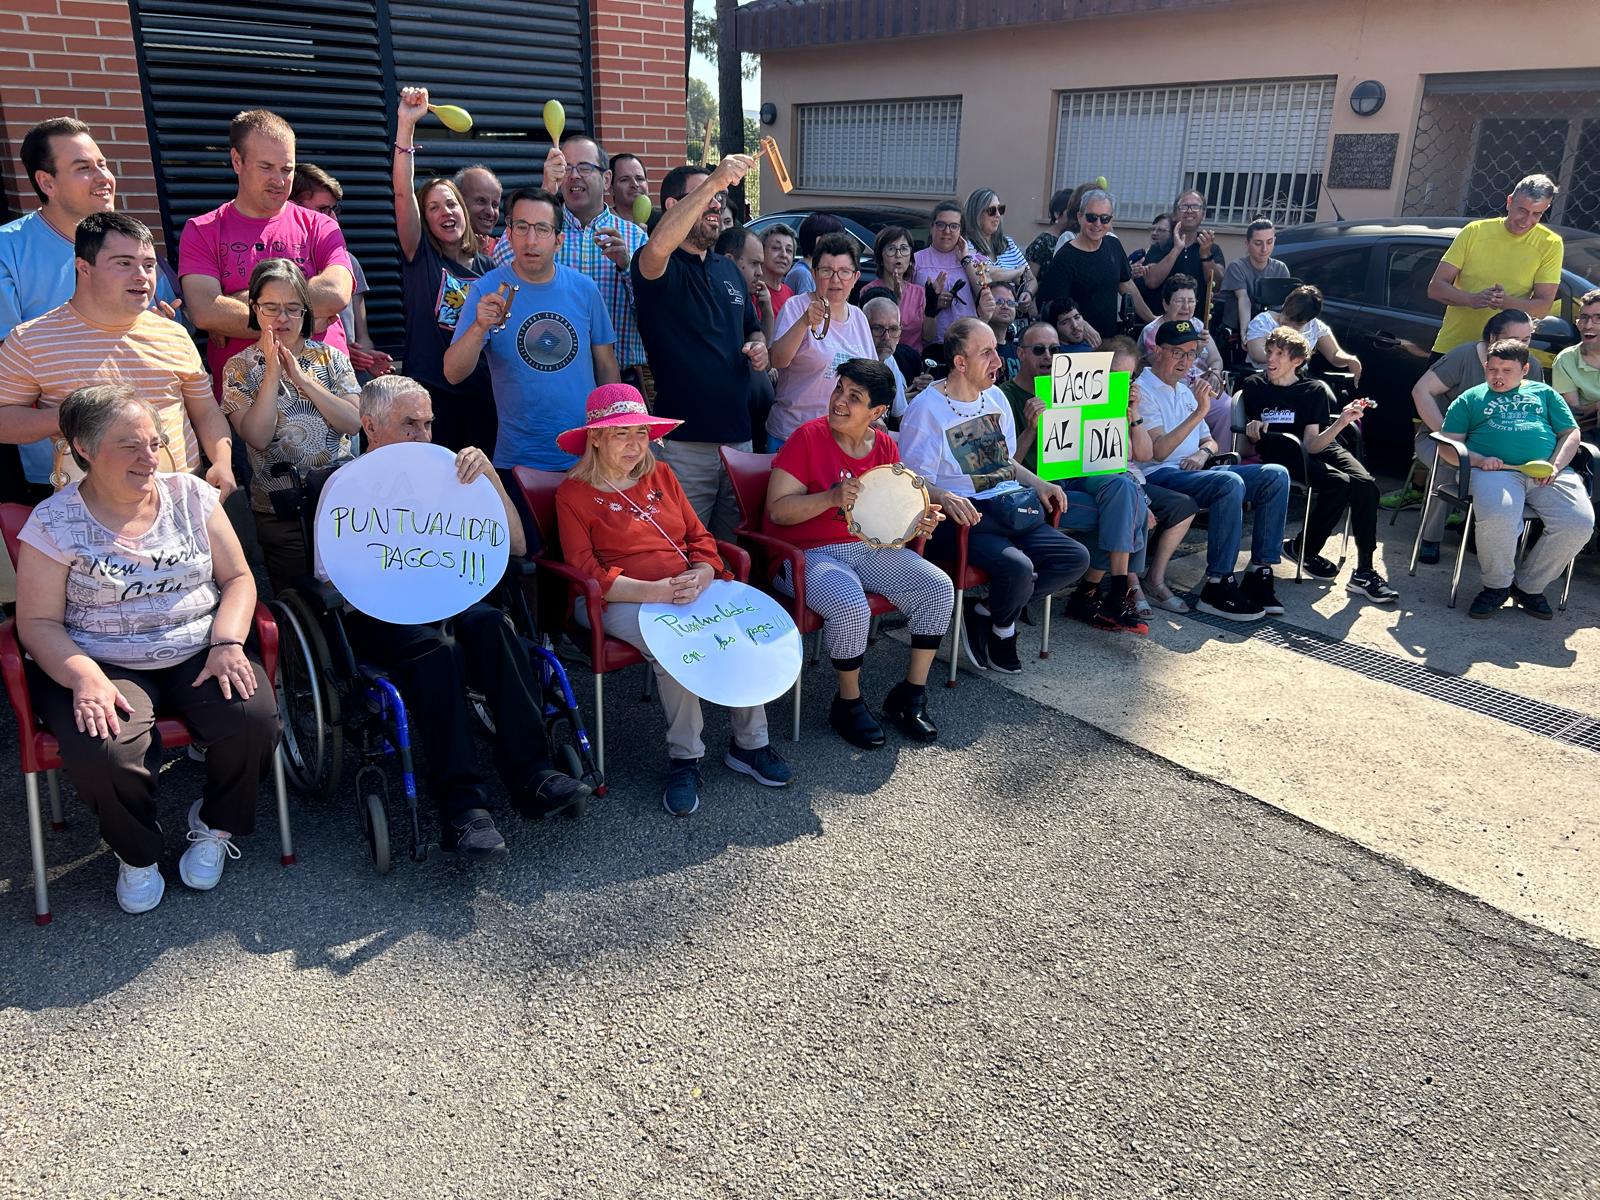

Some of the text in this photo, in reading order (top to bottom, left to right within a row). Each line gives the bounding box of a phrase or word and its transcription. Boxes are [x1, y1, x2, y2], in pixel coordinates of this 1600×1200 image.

[1053, 355, 1104, 404] PAGOS
[1044, 420, 1073, 452] AL
[1090, 421, 1123, 462] DÍA
[330, 507, 506, 546] PUNTUALIDAD
[89, 535, 201, 577] New York
[682, 650, 706, 664] en
[714, 633, 736, 650] los
